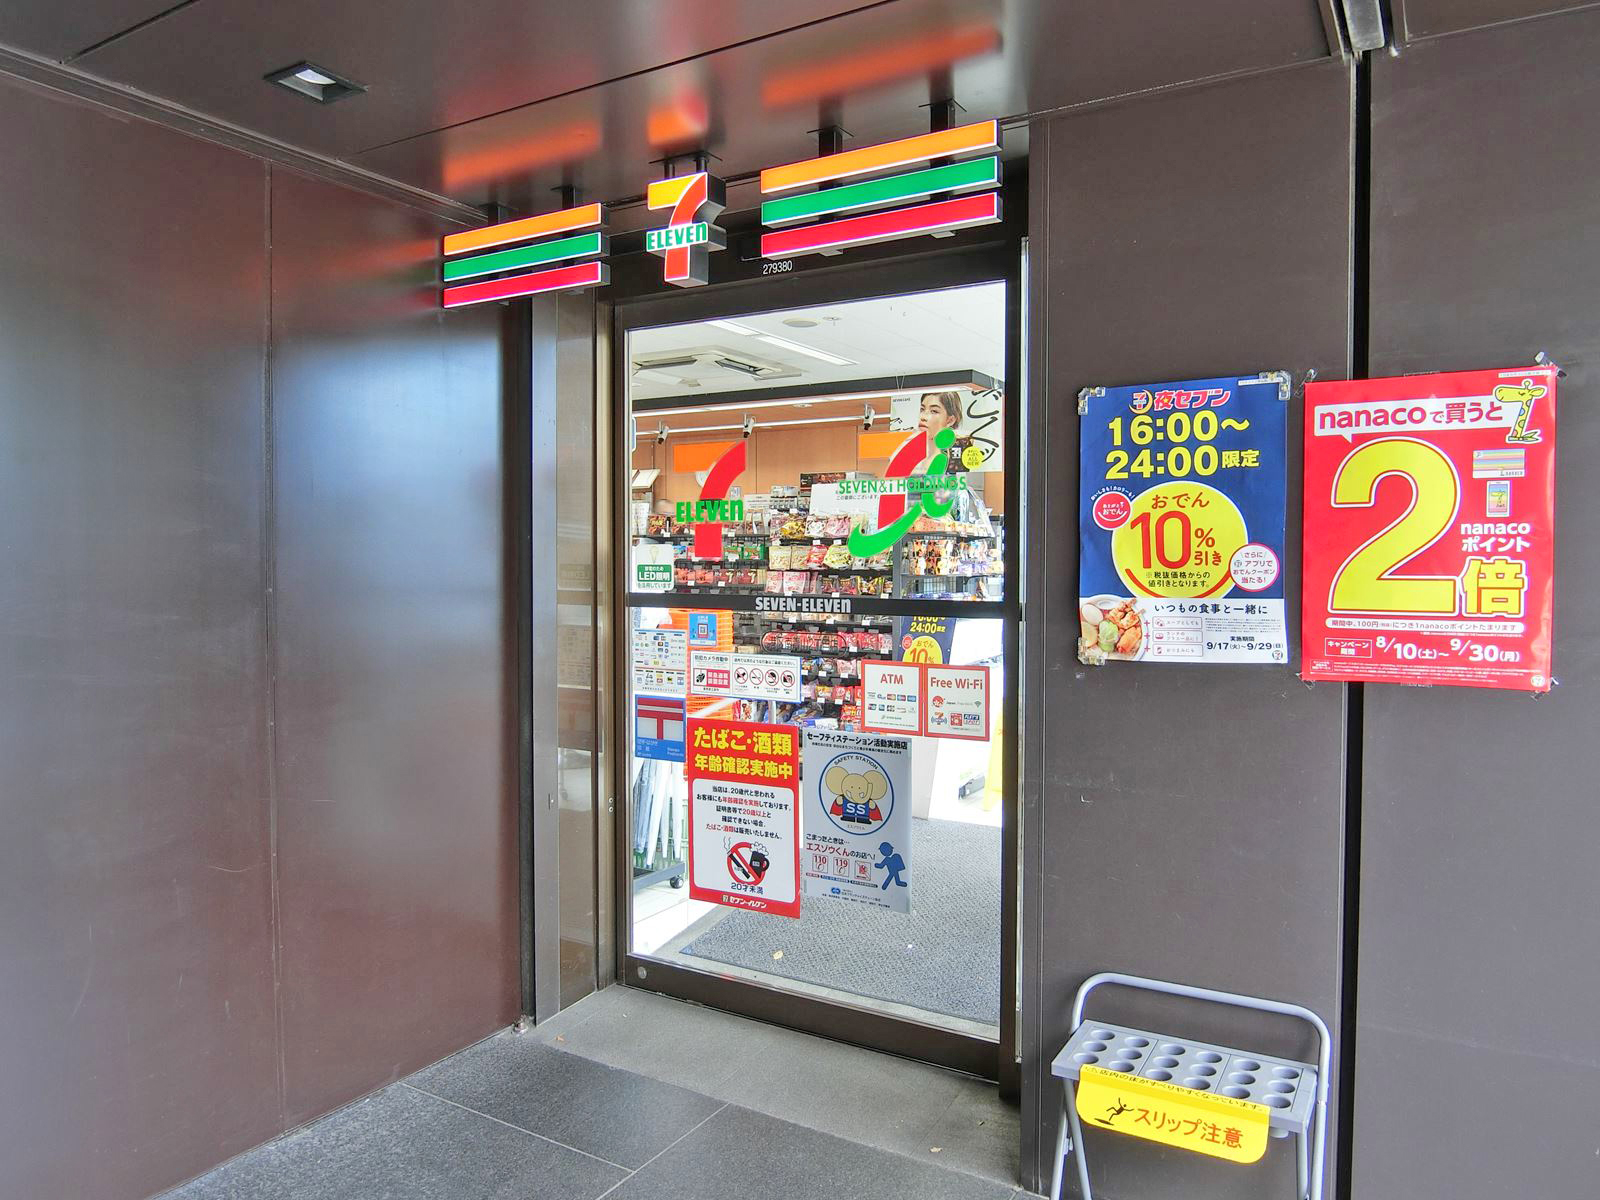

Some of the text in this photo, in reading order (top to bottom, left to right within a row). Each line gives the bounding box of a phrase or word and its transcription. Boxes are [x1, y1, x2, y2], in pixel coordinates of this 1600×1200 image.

[762, 260, 793, 275] 279380
[1153, 388, 1231, 411] 夜セブン
[897, 476, 967, 493] HOLDINGS
[1151, 492, 1210, 509] おでん
[1328, 438, 1460, 615] 2
[1460, 523, 1531, 535] nanaco
[1461, 536, 1531, 553] ポイント
[1194, 550, 1223, 567] 引き
[1147, 579, 1211, 588] 値引きとなります。
[1461, 557, 1526, 616] 倍
[1154, 603, 1268, 614] いつもの食事と一緒に
[1327, 641, 1369, 649] キャンペーン
[880, 673, 903, 685] ATM
[930, 677, 983, 690] Free Wi-Fi
[694, 726, 792, 757] たばこ・酒類
[806, 731, 909, 750] セーフティステーション活動実施店
[694, 753, 793, 780] 年齢確認実施中
[833, 755, 879, 772] SAFETY STATION
[814, 855, 828, 865] 110
[834, 858, 848, 868] 119
[1134, 1107, 1244, 1150] スリップ注意
